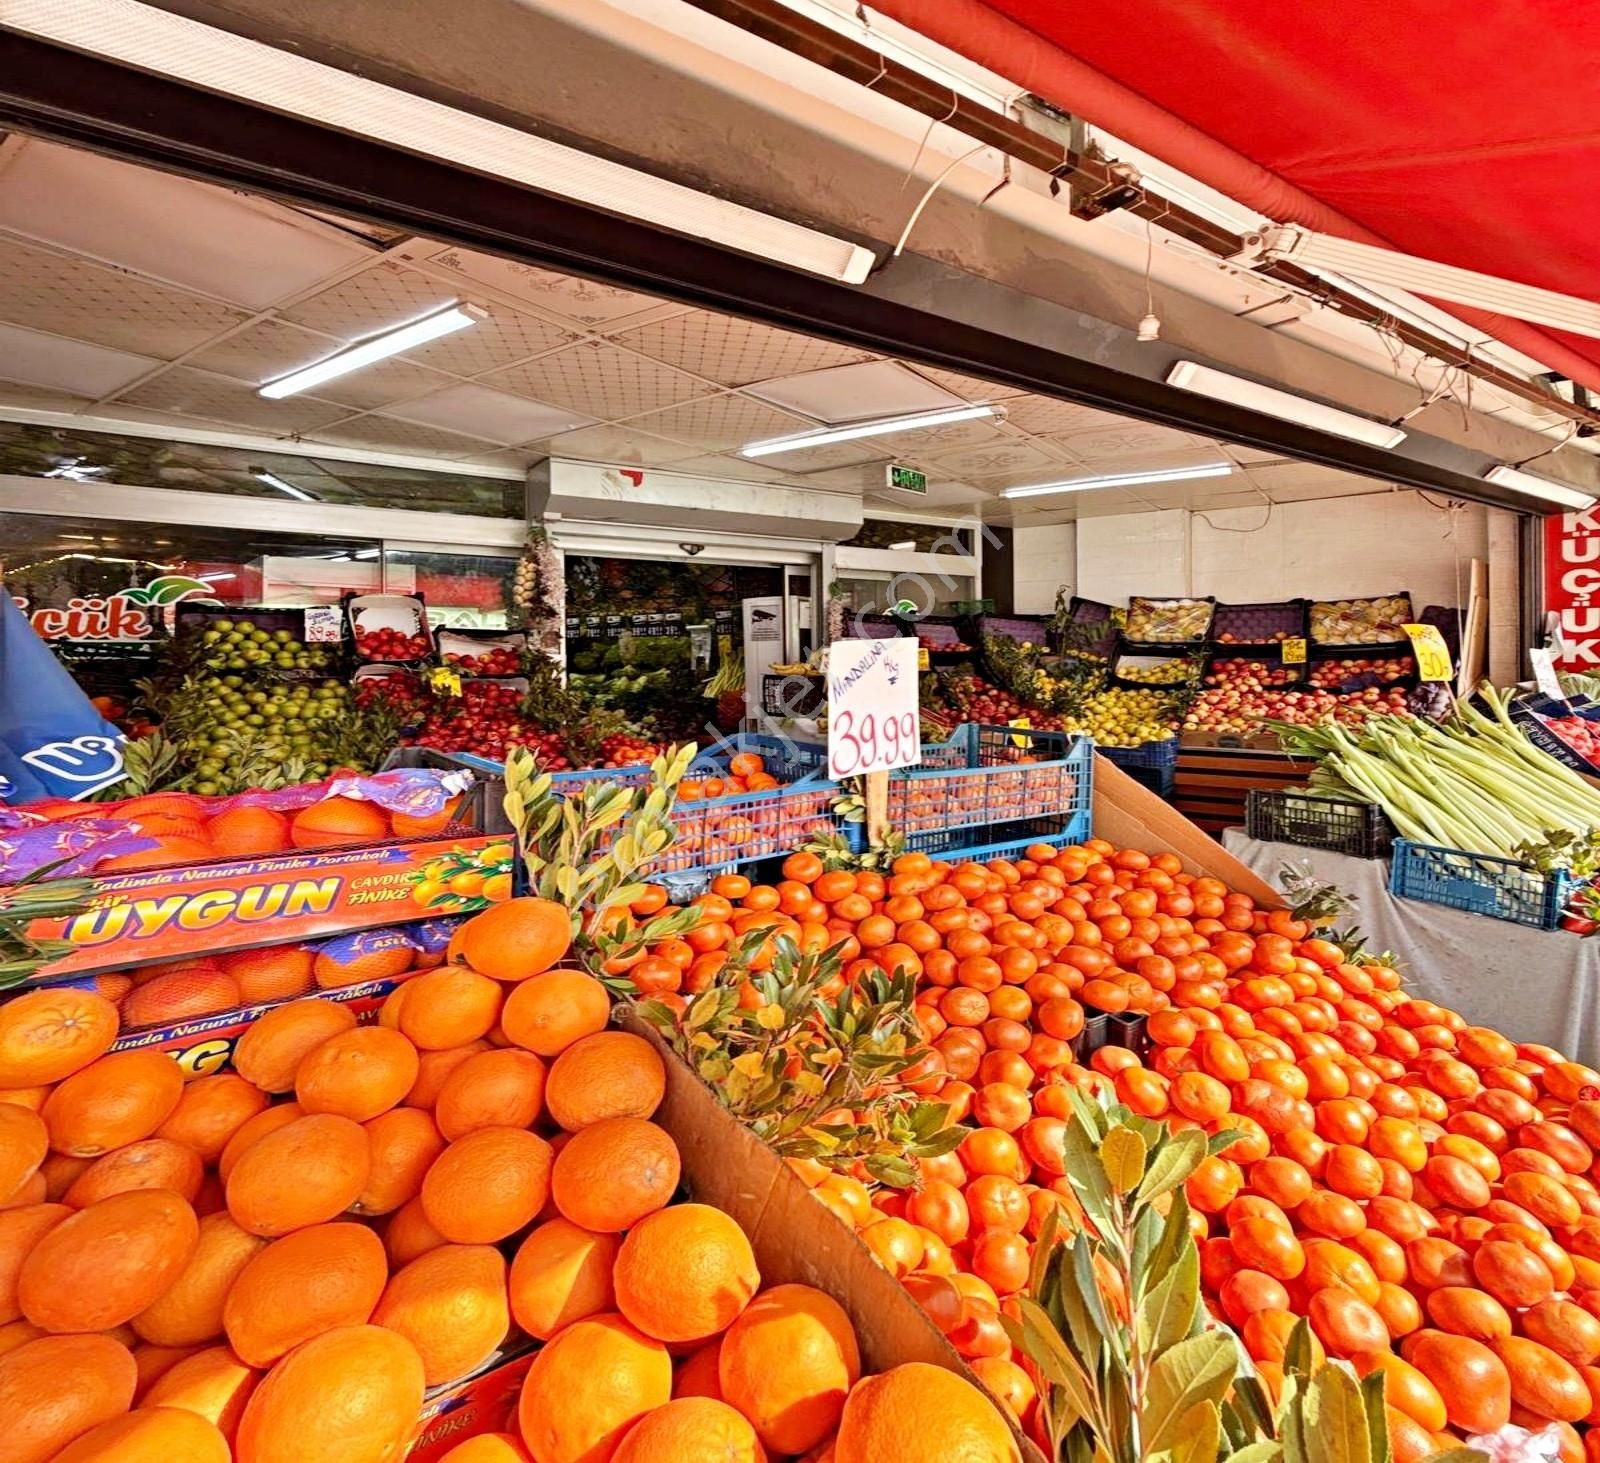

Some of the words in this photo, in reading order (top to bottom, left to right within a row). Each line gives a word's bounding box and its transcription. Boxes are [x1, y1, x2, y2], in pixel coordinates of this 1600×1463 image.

[1561, 504, 1600, 663] KÜÇÜK
[832, 711, 917, 775] 39.99
[179, 864, 251, 883] Naturel
[255, 857, 311, 872] Finike
[69, 877, 340, 944] UYGUN
[170, 1011, 243, 1038] Naturel
